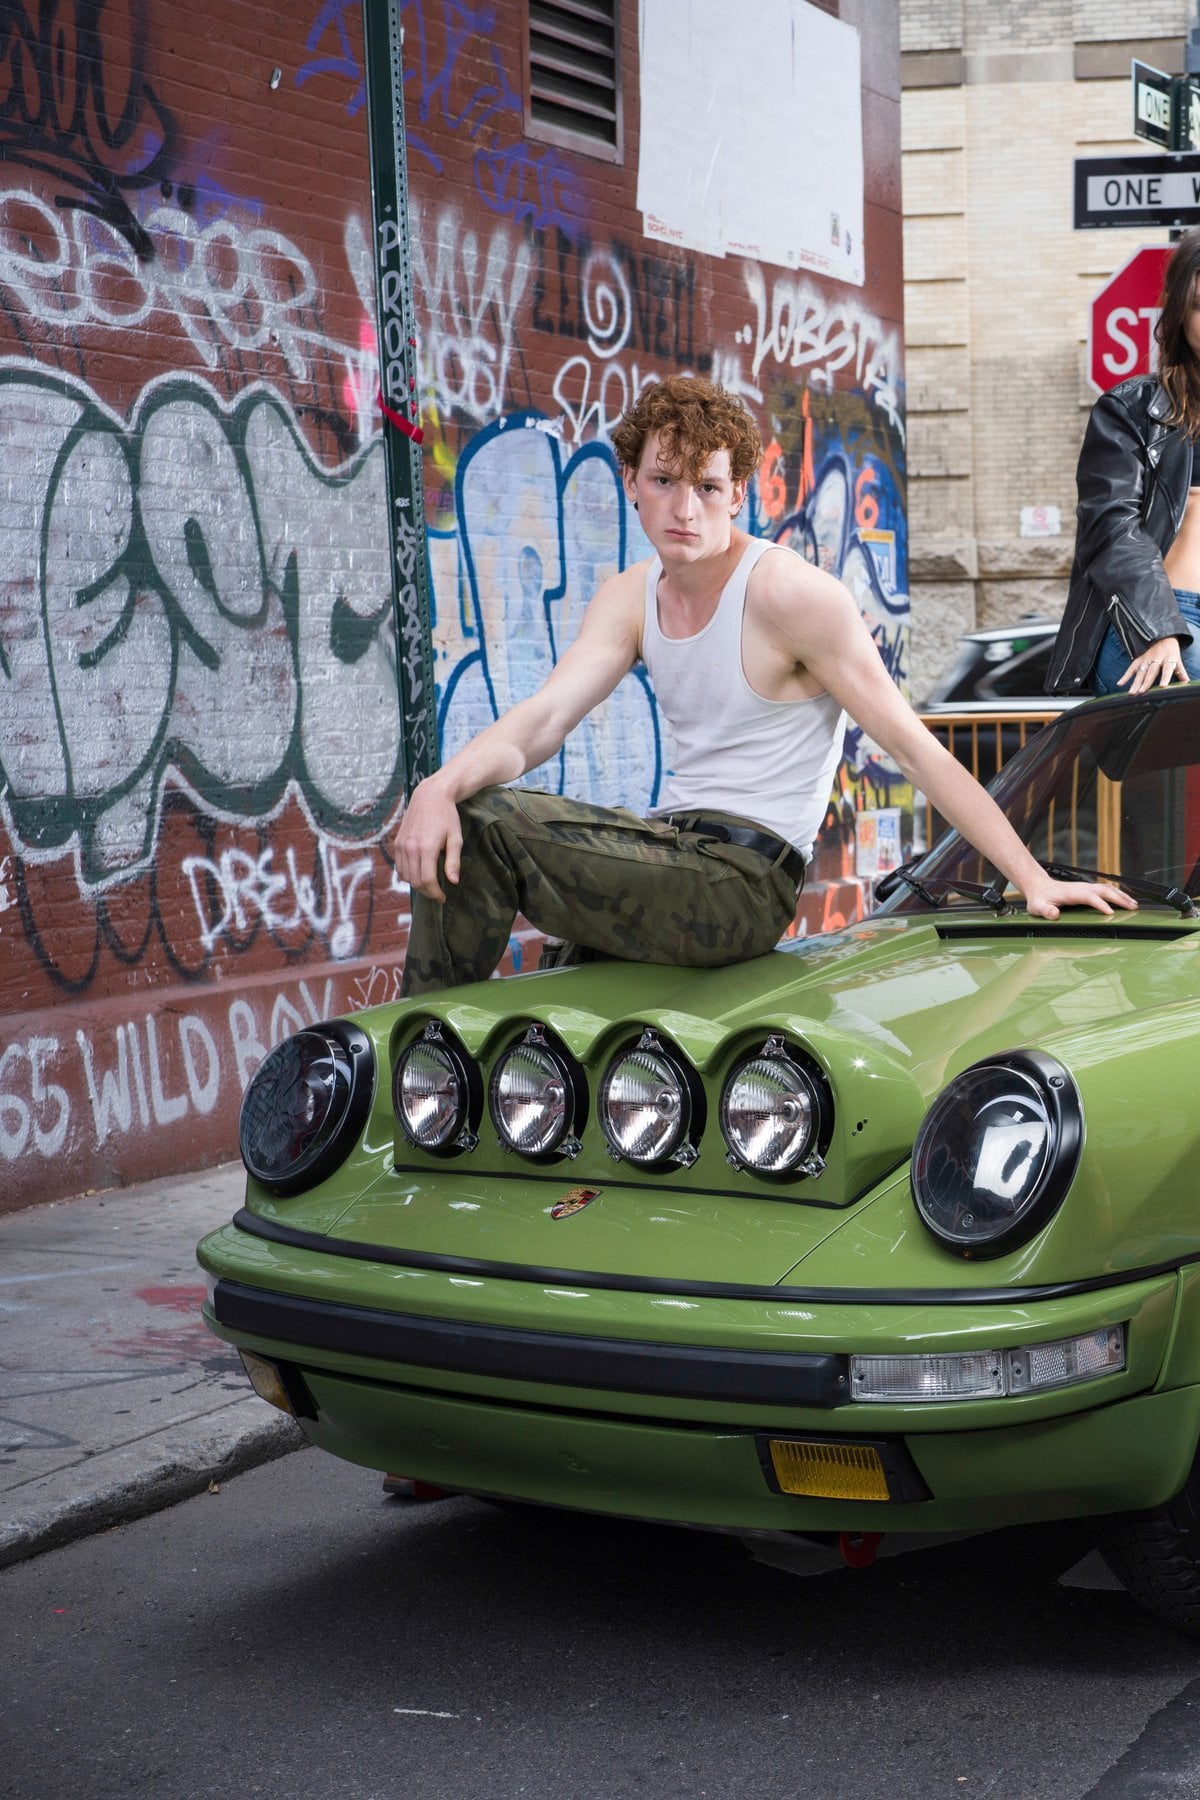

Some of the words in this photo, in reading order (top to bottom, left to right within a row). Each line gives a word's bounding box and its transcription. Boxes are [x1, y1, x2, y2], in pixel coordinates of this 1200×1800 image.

[1146, 91, 1169, 126] ONE
[1104, 178, 1162, 207] ONE
[1102, 306, 1164, 376] ST
[76, 1013, 221, 1150] WILD
